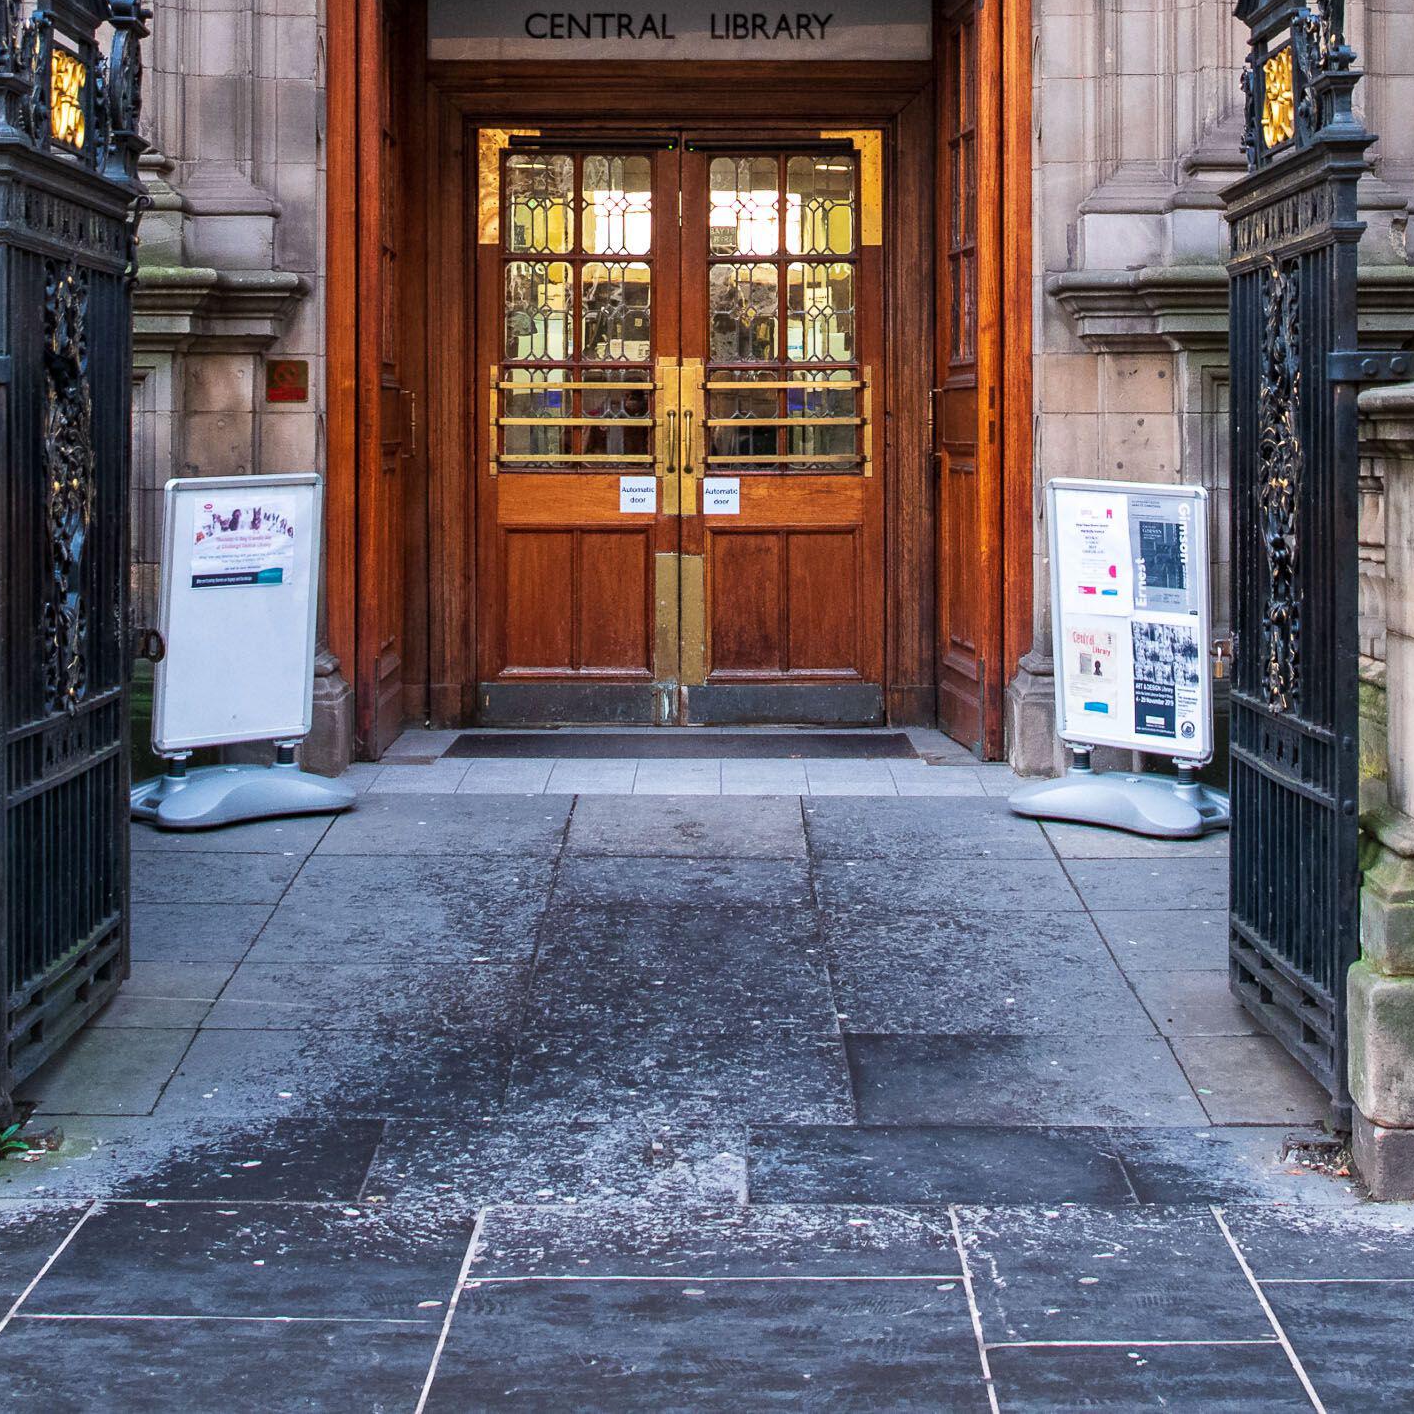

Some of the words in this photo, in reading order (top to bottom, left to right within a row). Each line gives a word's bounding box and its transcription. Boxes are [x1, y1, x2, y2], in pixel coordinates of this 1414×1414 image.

[524, 13, 676, 40] CENTRAL
[709, 13, 834, 40] LIBRARY
[1092, 646, 1111, 657] Library
